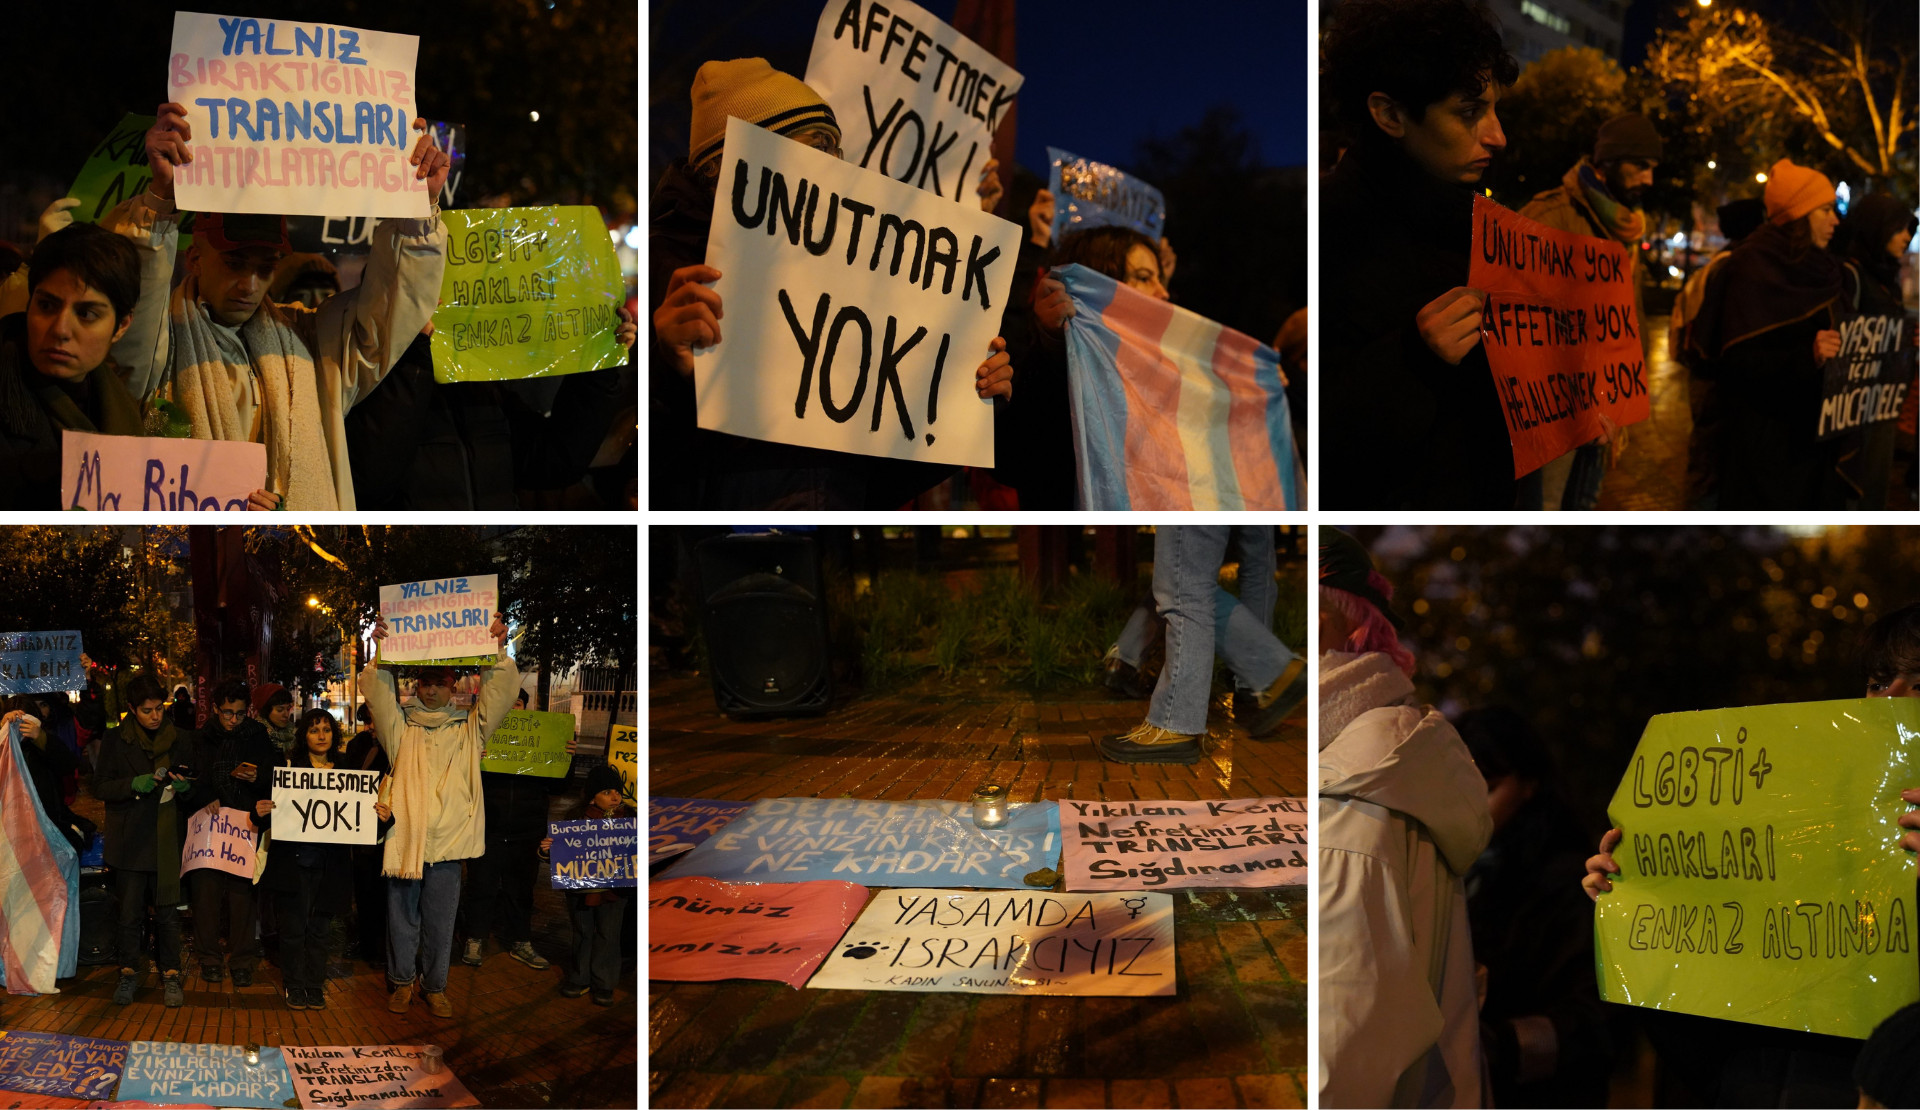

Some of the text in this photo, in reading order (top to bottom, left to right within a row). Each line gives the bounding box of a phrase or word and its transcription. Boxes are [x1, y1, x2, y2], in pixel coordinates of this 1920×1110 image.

[218, 18, 367, 66] YALNIZ
[171, 53, 412, 105] BIRAKTIĞINIZ
[834, 0, 1018, 133] AFFETMEK
[195, 97, 407, 151] TRANSLARI
[731, 158, 1001, 311] UNUTMAK
[1482, 213, 1624, 283] UNUTMAK YOK
[453, 270, 556, 306] HAKLARI
[1594, 303, 1636, 342] YOK
[1838, 314, 1905, 360] YAŞAM
[778, 289, 951, 447] YOK!
[1603, 360, 1647, 404] YOK
[400, 578, 472, 599] YALNIZ
[389, 608, 489, 633] TRANSLARI
[273, 769, 381, 795] HELALLEŞMEK
[291, 798, 361, 834] YOK!
[550, 821, 598, 835] Burada
[220, 841, 247, 866] Hon
[1082, 832, 1308, 854] TRANSLARI
[1634, 825, 1776, 881] HAKLARI
[743, 850, 1031, 878] NE KADAR?
[895, 895, 1098, 930] YAŞAMDA
[1629, 898, 1910, 960] ENKAZ ALTINDA
[885, 976, 941, 987] KADIN
[150, 1080, 280, 1101] NE KADAR?
[301, 1072, 407, 1086] TRANSLARI
